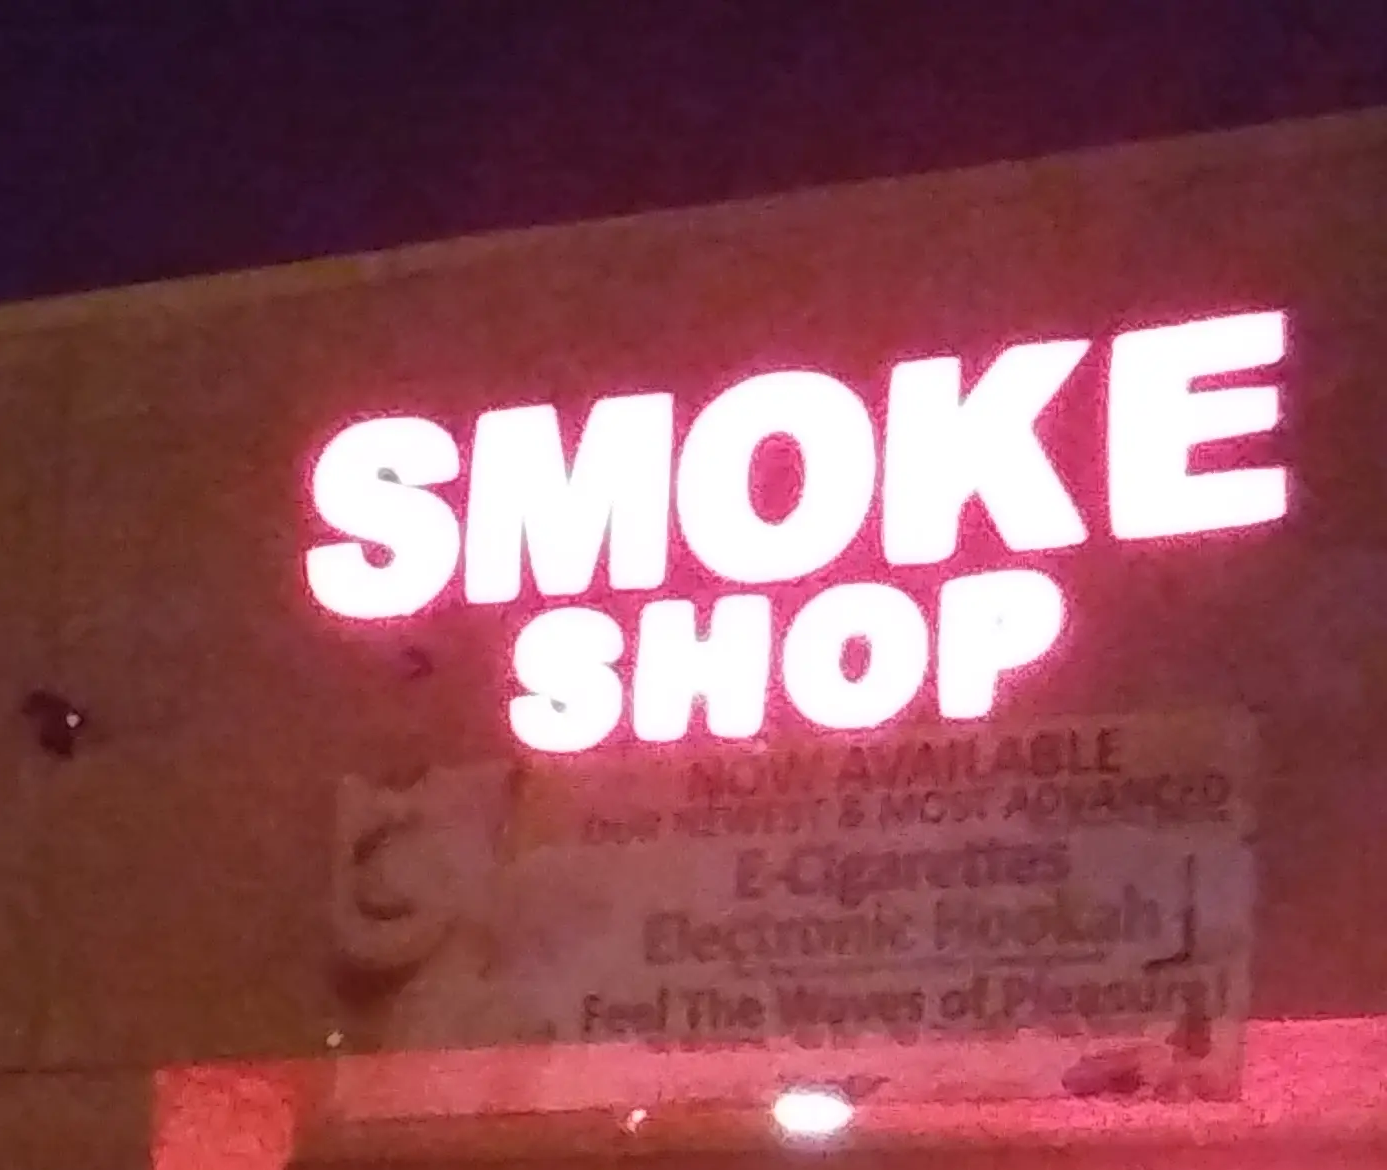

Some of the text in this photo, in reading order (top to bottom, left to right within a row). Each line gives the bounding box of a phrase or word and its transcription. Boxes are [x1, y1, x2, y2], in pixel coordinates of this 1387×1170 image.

[305, 310, 1289, 620] SMOKE
[509, 568, 1065, 752] SHOP
[688, 728, 1122, 800] NOW AVAILABLE
[674, 796, 825, 840] NEWEST
[880, 789, 987, 826] MOST
[1004, 773, 1230, 826] ADVANCED
[736, 840, 1072, 906] E-Cigarettes
[645, 884, 1162, 966] Electronic Hookah
[582, 993, 669, 1034] Feel
[687, 986, 765, 1030] The
[940, 978, 987, 1020] of
